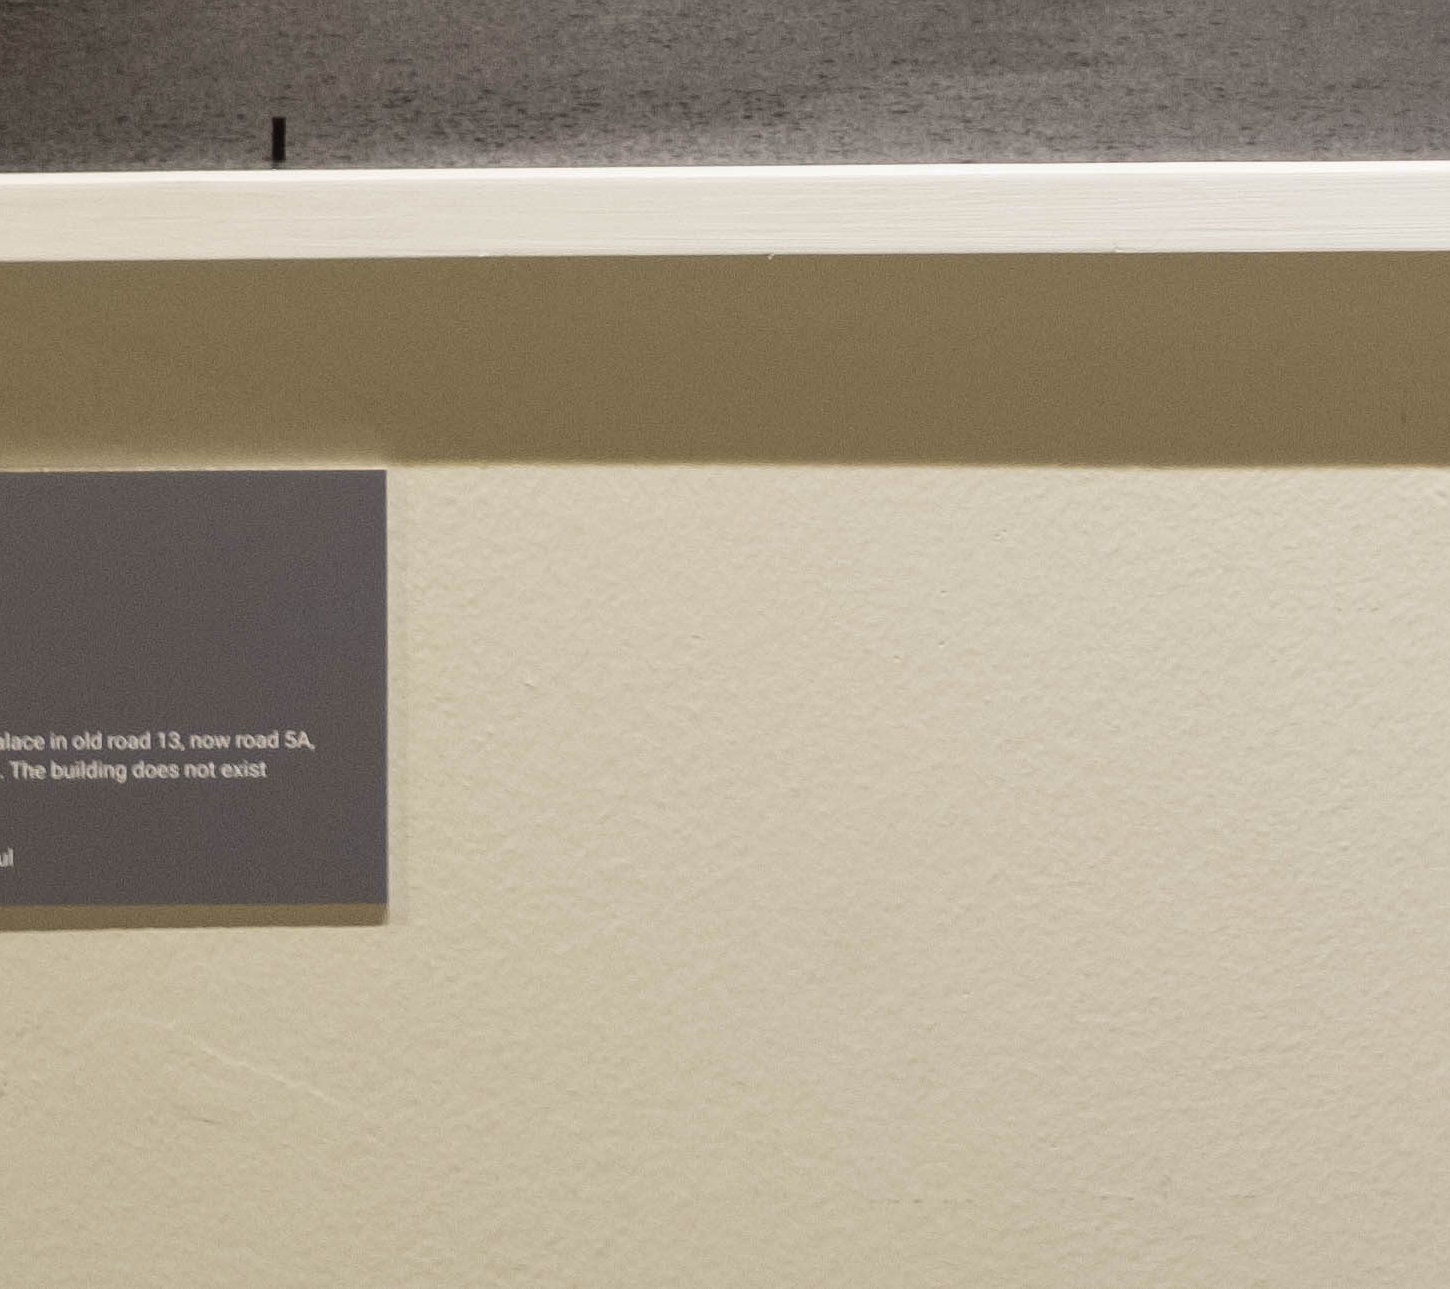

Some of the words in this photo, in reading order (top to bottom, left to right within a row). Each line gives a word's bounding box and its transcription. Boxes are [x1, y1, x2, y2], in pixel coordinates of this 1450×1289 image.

[49, 732, 68, 750] in
[71, 731, 103, 751] old
[106, 731, 152, 751] road
[157, 730, 186, 752] 13,
[189, 734, 231, 750] now
[235, 730, 280, 750] road
[9, 760, 47, 780] The
[50, 760, 128, 784] building
[131, 760, 180, 779] does
[183, 761, 216, 779] not
[219, 760, 267, 779] exist
